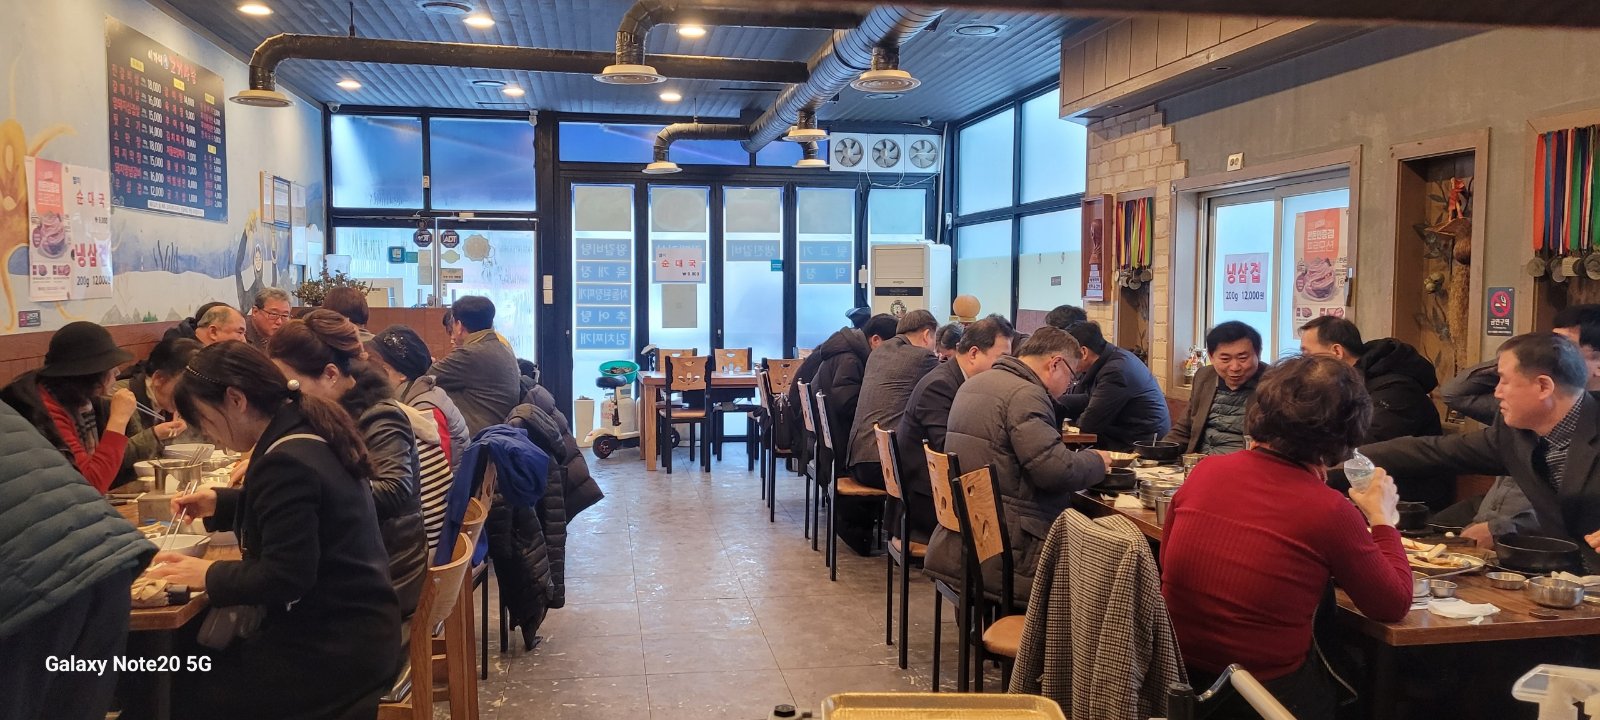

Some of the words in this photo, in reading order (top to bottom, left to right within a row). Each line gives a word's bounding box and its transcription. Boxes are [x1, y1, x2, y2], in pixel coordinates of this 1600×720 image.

[76, 189, 105, 208] 순대국
[443, 235, 457, 243] ADT
[661, 259, 696, 268] 순대국
[1226, 262, 1261, 284] 냉삼겹
[77, 276, 90, 288] 200g
[1226, 291, 1239, 302] 200g
[1241, 290, 1265, 301] 12,000원
[1490, 318, 1510, 326] 금연구역
